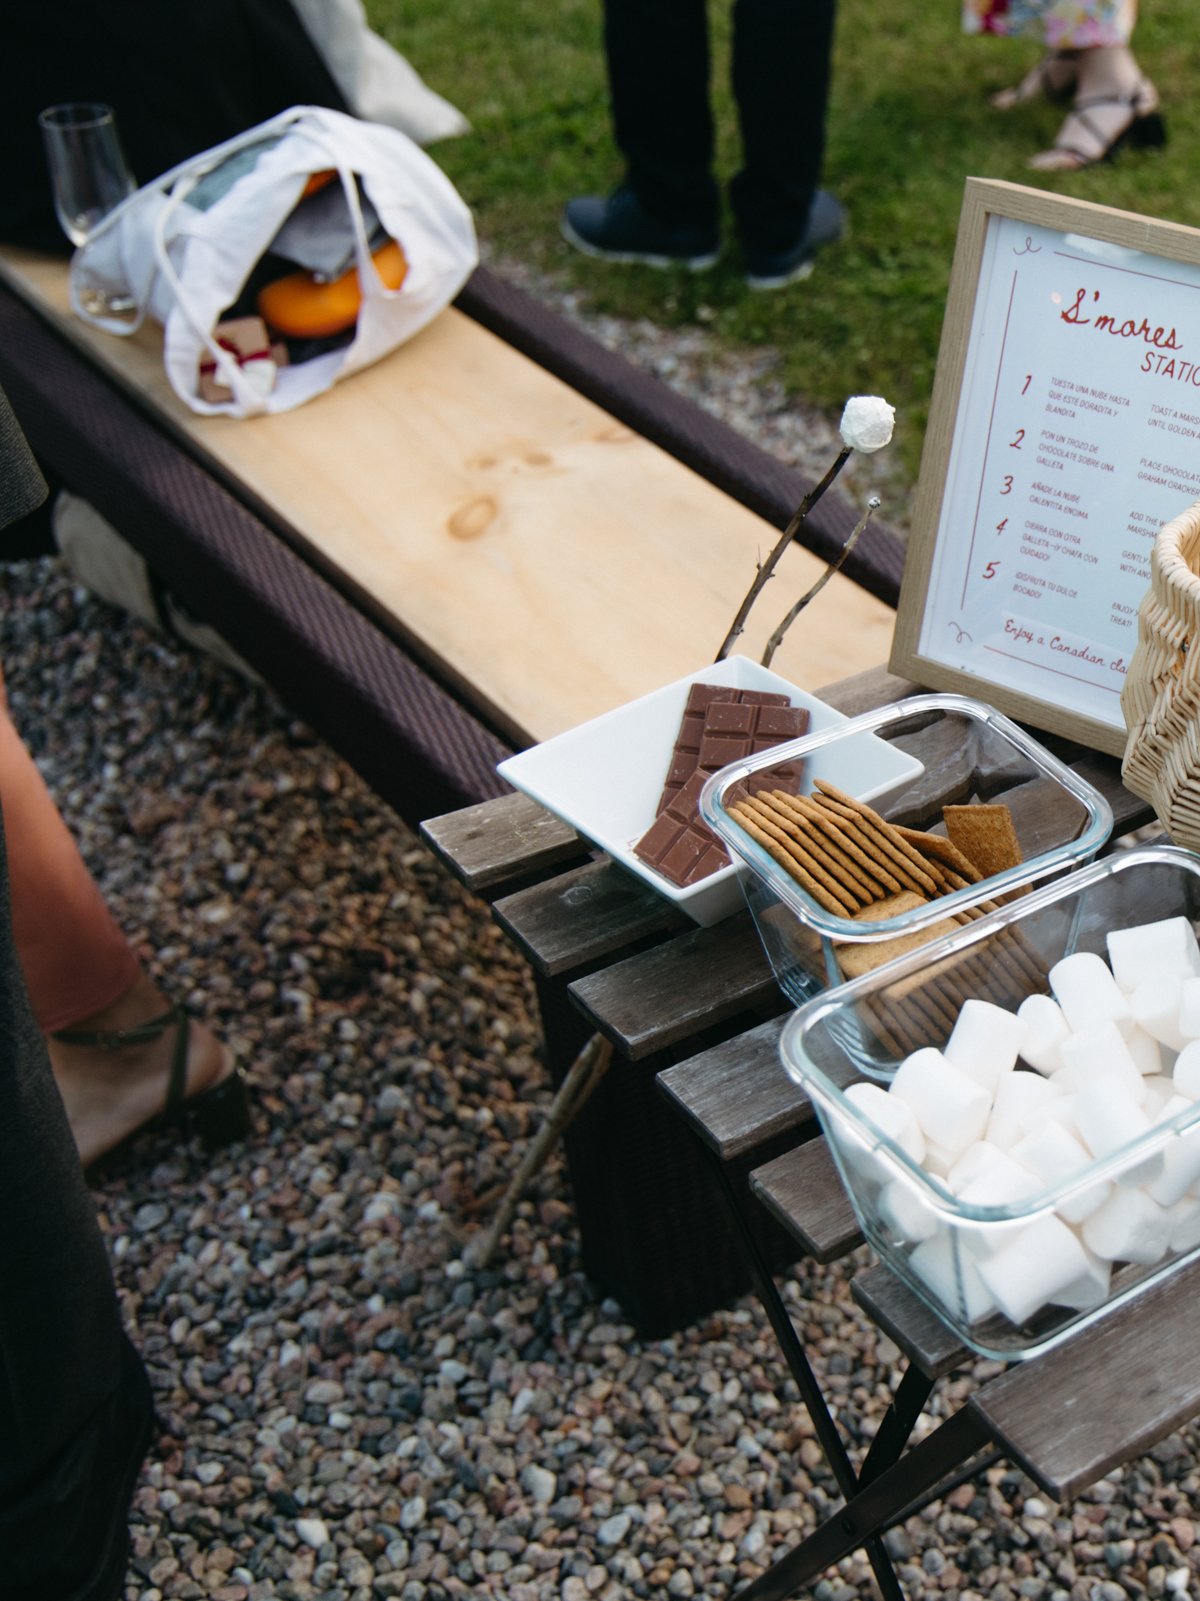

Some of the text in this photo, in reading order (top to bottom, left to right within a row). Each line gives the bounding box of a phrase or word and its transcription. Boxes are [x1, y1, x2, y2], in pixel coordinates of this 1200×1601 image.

[1061, 288, 1183, 350] S'mores
[1021, 375, 1032, 395] 1
[1051, 377, 1130, 406] TUESTA UNA NUBE HASTA
[1045, 403, 1076, 418] BLANDITA
[1048, 390, 1061, 401] QUE
[1079, 399, 1112, 416] DORADITA
[1151, 404, 1172, 417] TOAST
[1147, 418, 1166, 430] UNTIL
[1167, 423, 1195, 439] GOLDEN
[1009, 428, 1025, 450] 2
[1040, 430, 1099, 454] PON UN TROZO DE
[1036, 455, 1064, 471] GALLETA
[1038, 442, 1115, 473] CHOCOLATE SOBRE UNA
[1140, 457, 1161, 471] PLACE
[999, 475, 1014, 495] 3
[1137, 471, 1200, 497] GRAHAM CRACKER
[1029, 494, 1089, 520] CALENTITA ENCIMA
[1062, 491, 1081, 504] NUBE
[996, 517, 1008, 536] 4
[1129, 511, 1144, 521] ADD
[1145, 515, 1158, 526] THE
[1024, 520, 1081, 545] CIERRA CON OTRA
[1127, 524, 1158, 539] MARSHM
[1083, 553, 1099, 564] CON
[1121, 550, 1149, 564] GENTLY
[982, 561, 1001, 580] 5
[1120, 562, 1152, 580] WITH ANO
[1048, 582, 1057, 591] TU
[1056, 584, 1078, 599] DULCE
[1112, 602, 1134, 615] ENJOY
[1004, 619, 1128, 674] Enjoy a Canadian cla
